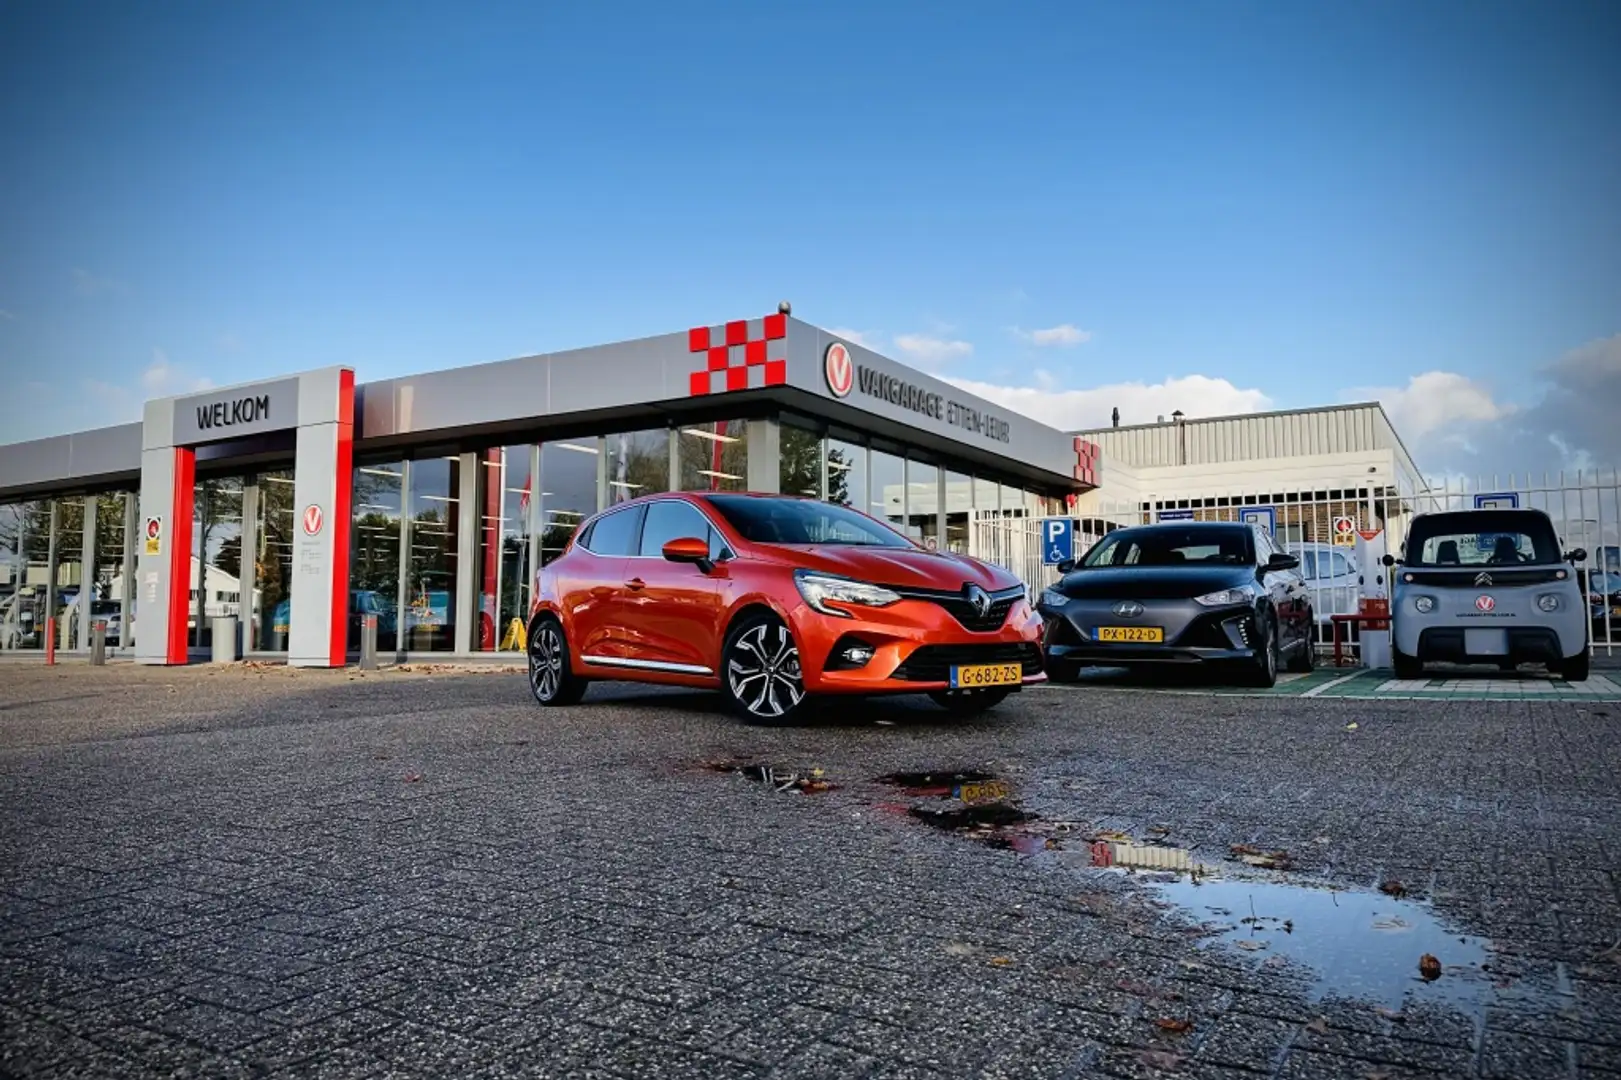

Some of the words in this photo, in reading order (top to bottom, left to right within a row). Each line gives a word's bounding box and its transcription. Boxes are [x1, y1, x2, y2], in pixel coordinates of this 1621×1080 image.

[196, 394, 270, 430] WELKOM
[857, 364, 943, 421] VAKGARAGE
[947, 400, 1010, 444] ETTEN-LEUR
[1049, 521, 1065, 543] P
[1103, 628, 1157, 641] PX-122-D
[962, 666, 1018, 684] G-682-ZS
